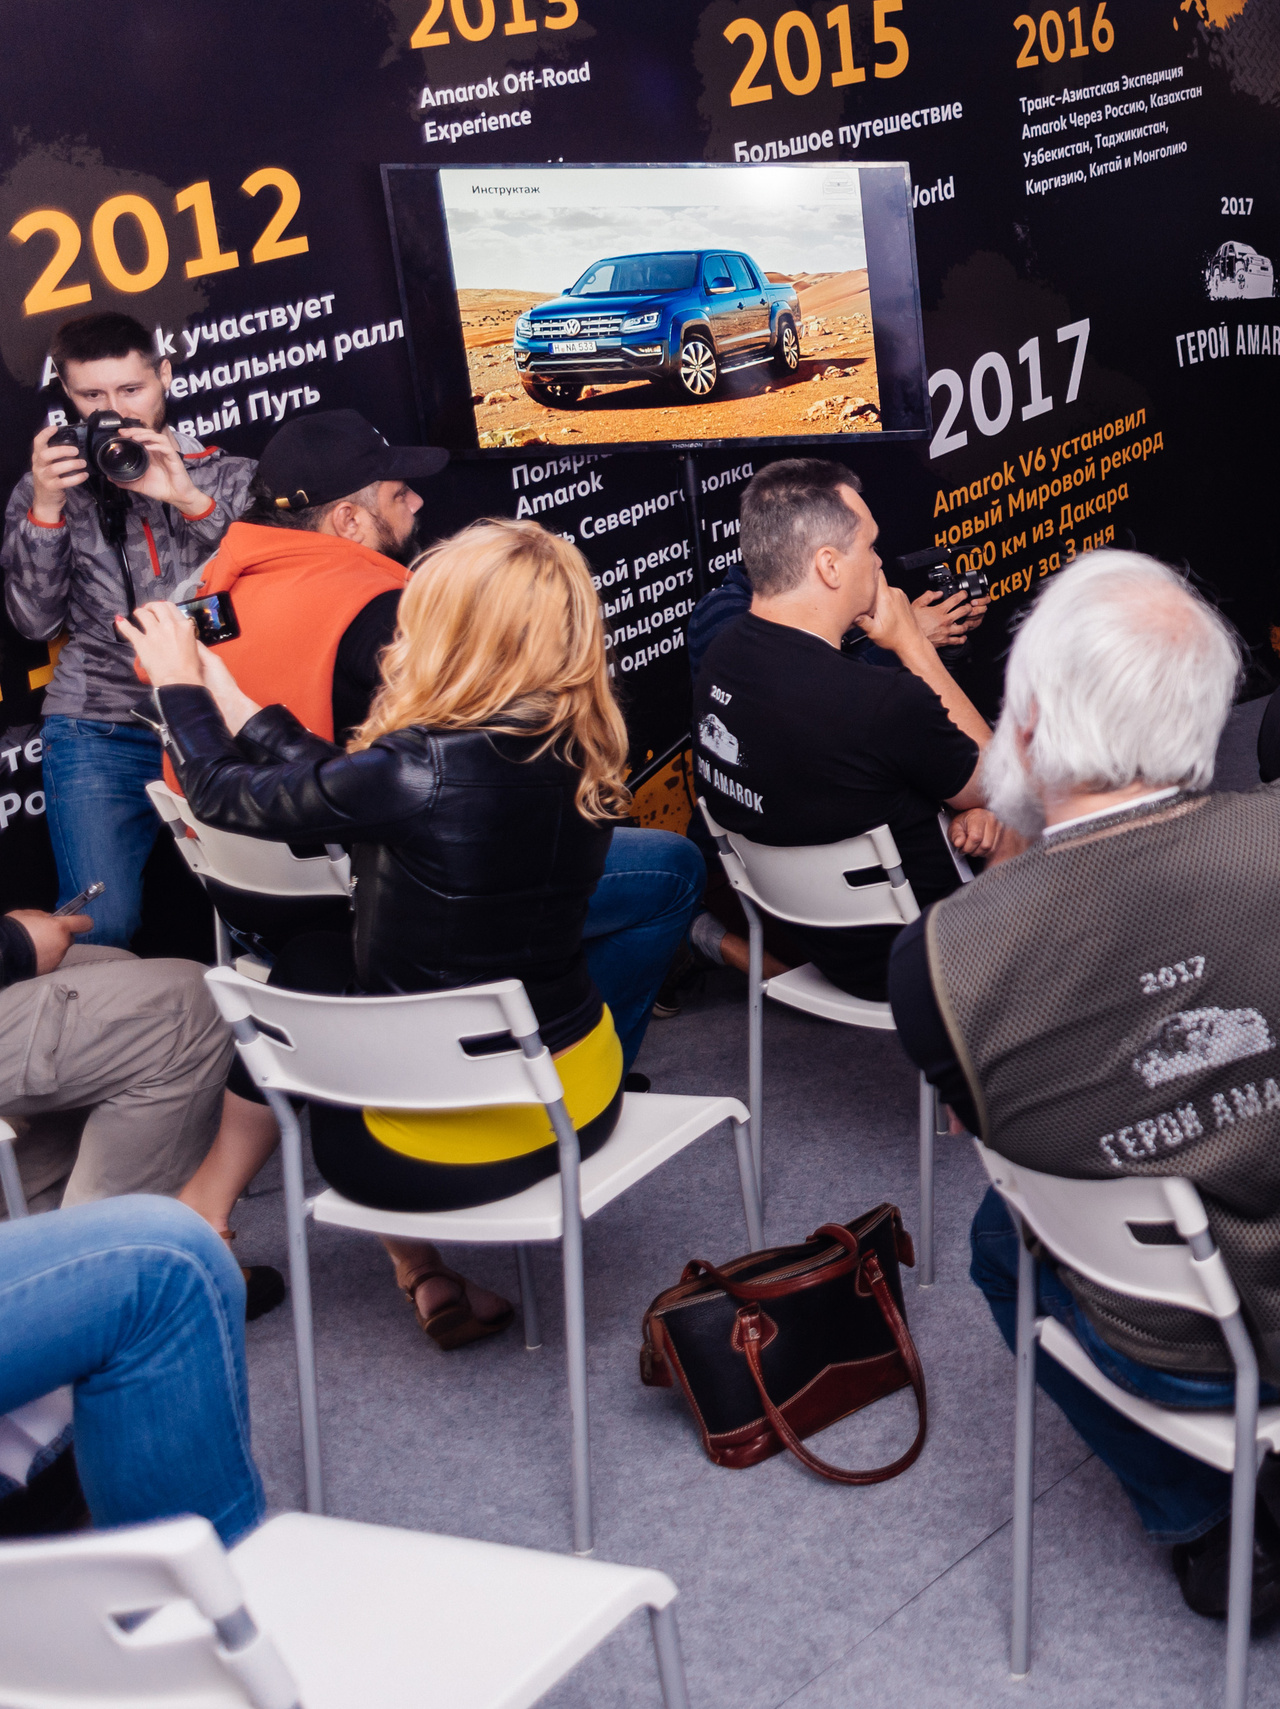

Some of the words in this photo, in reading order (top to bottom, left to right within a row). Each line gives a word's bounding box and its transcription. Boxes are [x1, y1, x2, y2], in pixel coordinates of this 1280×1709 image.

[723, 0, 910, 107] 2015
[1013, 3, 1115, 69] 2016
[420, 77, 500, 109] Amarok
[503, 61, 591, 95] Off-Road
[1122, 66, 1184, 92] Экспедиция
[424, 109, 532, 143] Experience
[734, 129, 834, 162] Большое
[838, 102, 963, 148] путешествие
[1022, 116, 1067, 140] Amarok
[1069, 108, 1103, 130] Через
[1105, 97, 1149, 120] Россию,
[1150, 86, 1203, 108] Казахстан
[1023, 138, 1093, 168] Узбекистан,
[1095, 120, 1169, 150] Таджикистан,
[1025, 169, 1087, 196] Киргизию,
[1090, 156, 1122, 179] Китай
[1124, 155, 1132, 169] и
[1133, 140, 1188, 166] Монголию
[472, 185, 540, 196] Инструктаж
[912, 176, 955, 208] orld
[1221, 196, 1254, 216] 2017
[10, 168, 309, 316] 2012
[181, 293, 335, 356] участвует
[1175, 321, 1230, 367] ГЕРОЙ
[167, 339, 326, 399] емальном
[334, 319, 404, 361] ралл
[248, 382, 321, 422] Путь
[927, 317, 1091, 460] 2017
[512, 454, 613, 490] Полярн
[933, 461, 1016, 518] Amarok
[1019, 447, 1047, 477] V6
[1050, 408, 1147, 472] установил
[516, 470, 604, 520] Amarok
[934, 499, 1004, 549] новый
[1008, 456, 1096, 518] Мировой
[1100, 431, 1164, 480] рекорд
[1001, 528, 1027, 559] км
[1032, 518, 1054, 544] из
[1058, 482, 1129, 531] Дакара
[989, 563, 1033, 601] скву
[1038, 550, 1061, 577] за
[1065, 538, 1077, 563] 3
[1082, 524, 1115, 553] дня
[621, 626, 685, 672] одной
[710, 685, 732, 706] 2017
[713, 768, 764, 814] AMAROK
[1139, 955, 1206, 994] 2017
